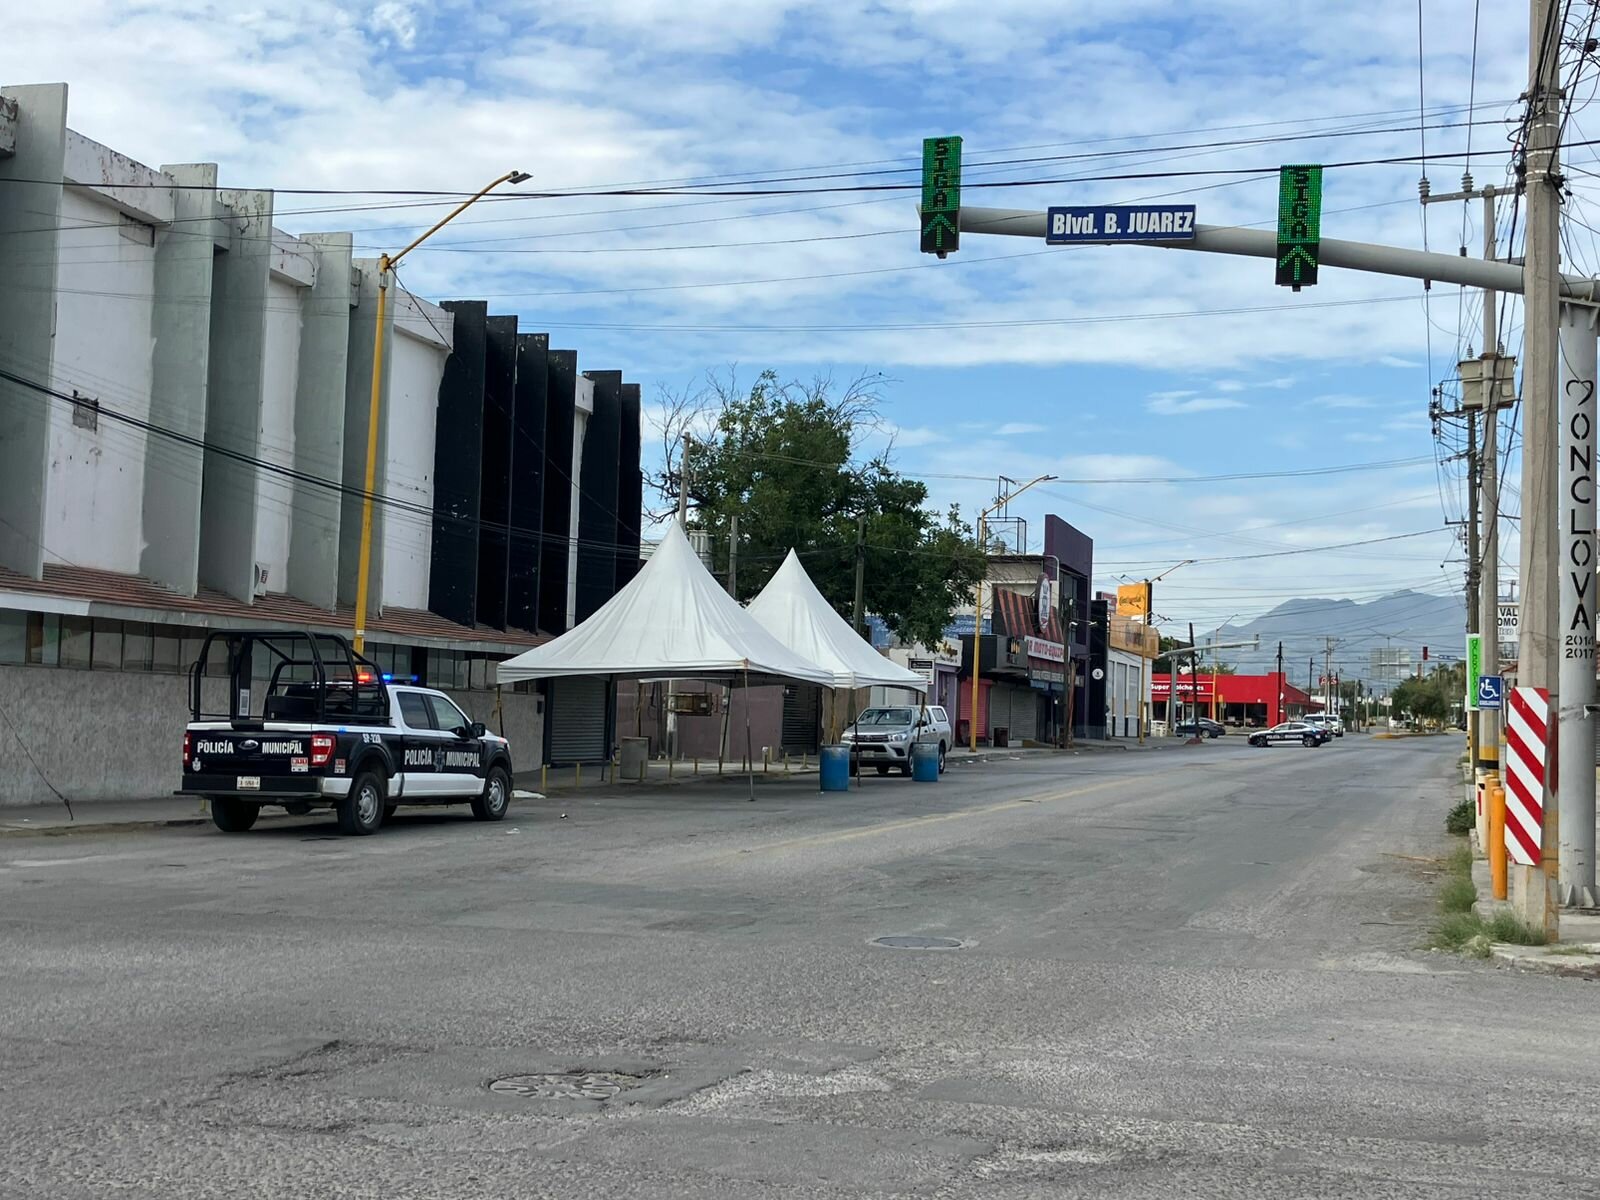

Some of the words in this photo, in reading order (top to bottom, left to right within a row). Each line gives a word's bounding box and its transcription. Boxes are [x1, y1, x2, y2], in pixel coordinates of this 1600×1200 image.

[933, 139, 949, 208] SIGA
[1291, 168, 1309, 239] SIGA
[1052, 213, 1098, 234] Blvd.
[1104, 212, 1121, 234] B.
[1127, 211, 1194, 233] JUAREZ
[1500, 608, 1518, 617] VAL
[1565, 648, 1594, 659] 2017
[1151, 683, 1169, 691] Super
[197, 739, 235, 754] POLICÍA
[262, 742, 304, 754] MUNICIPAL
[404, 747, 432, 765] POLICÍA
[446, 751, 480, 767] MUNICIPAL
